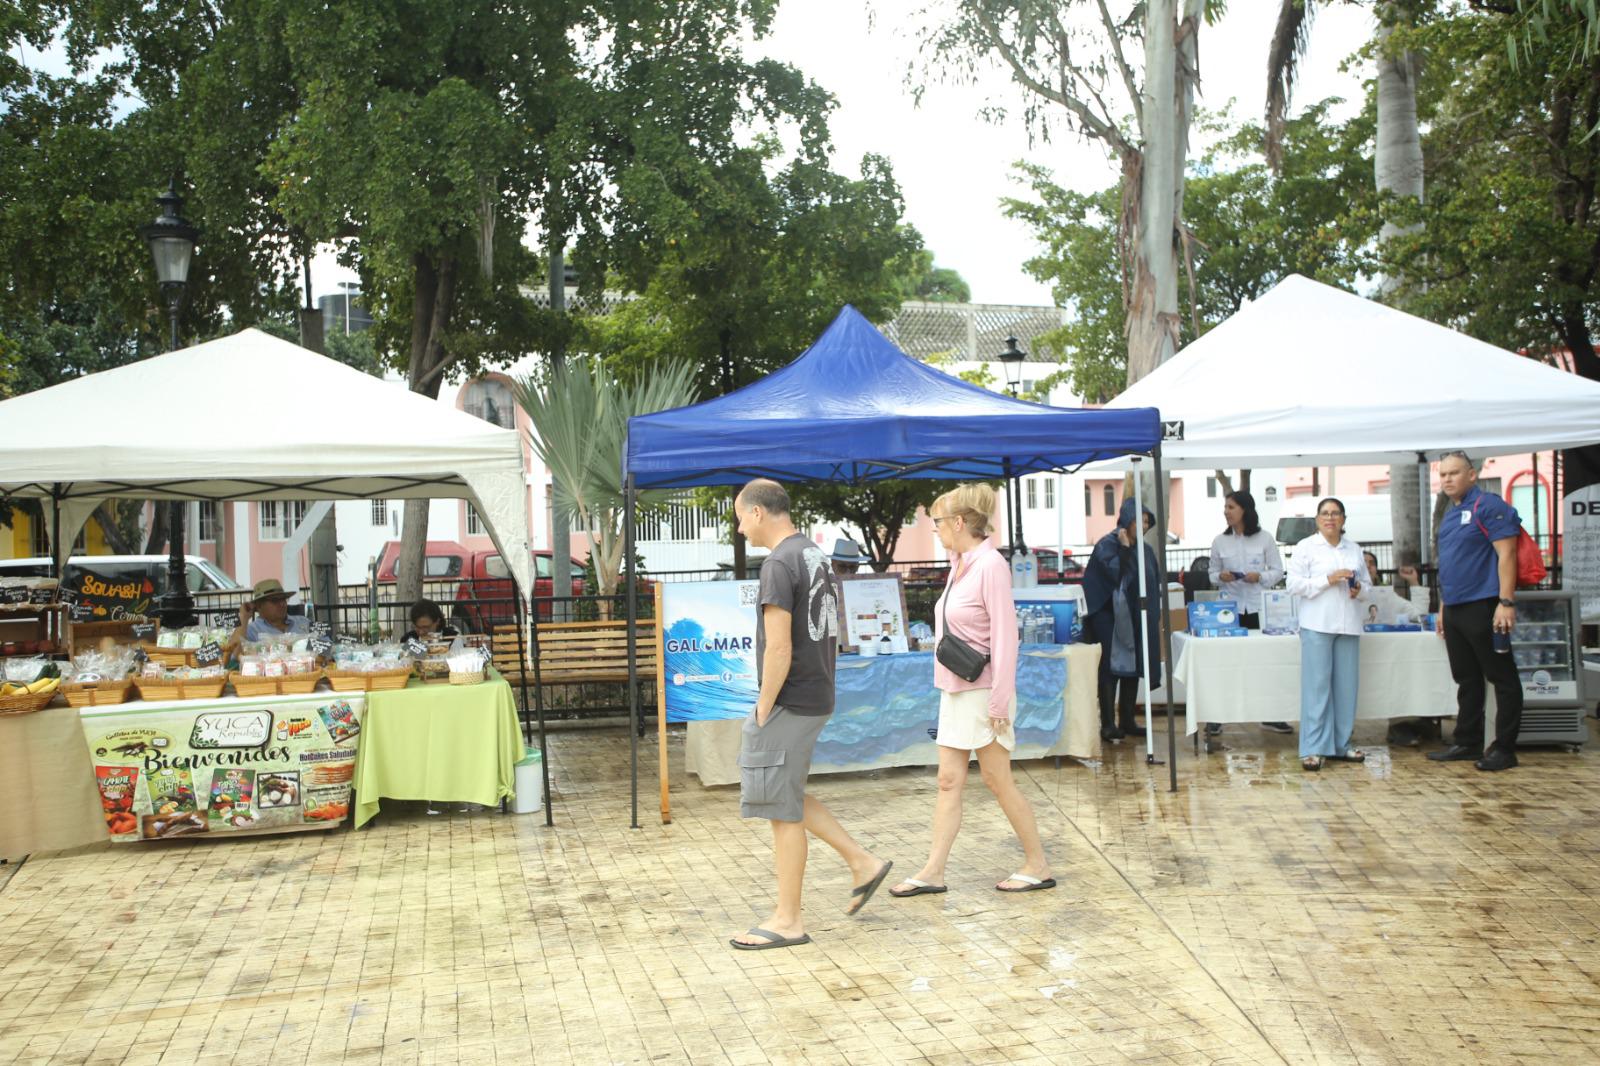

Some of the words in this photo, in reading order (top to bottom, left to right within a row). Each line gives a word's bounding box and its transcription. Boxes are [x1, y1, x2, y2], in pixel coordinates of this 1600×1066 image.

[81, 575, 142, 599] SQUASH
[202, 716, 264, 730] YUCA
[144, 746, 291, 776] Bienvenidos
